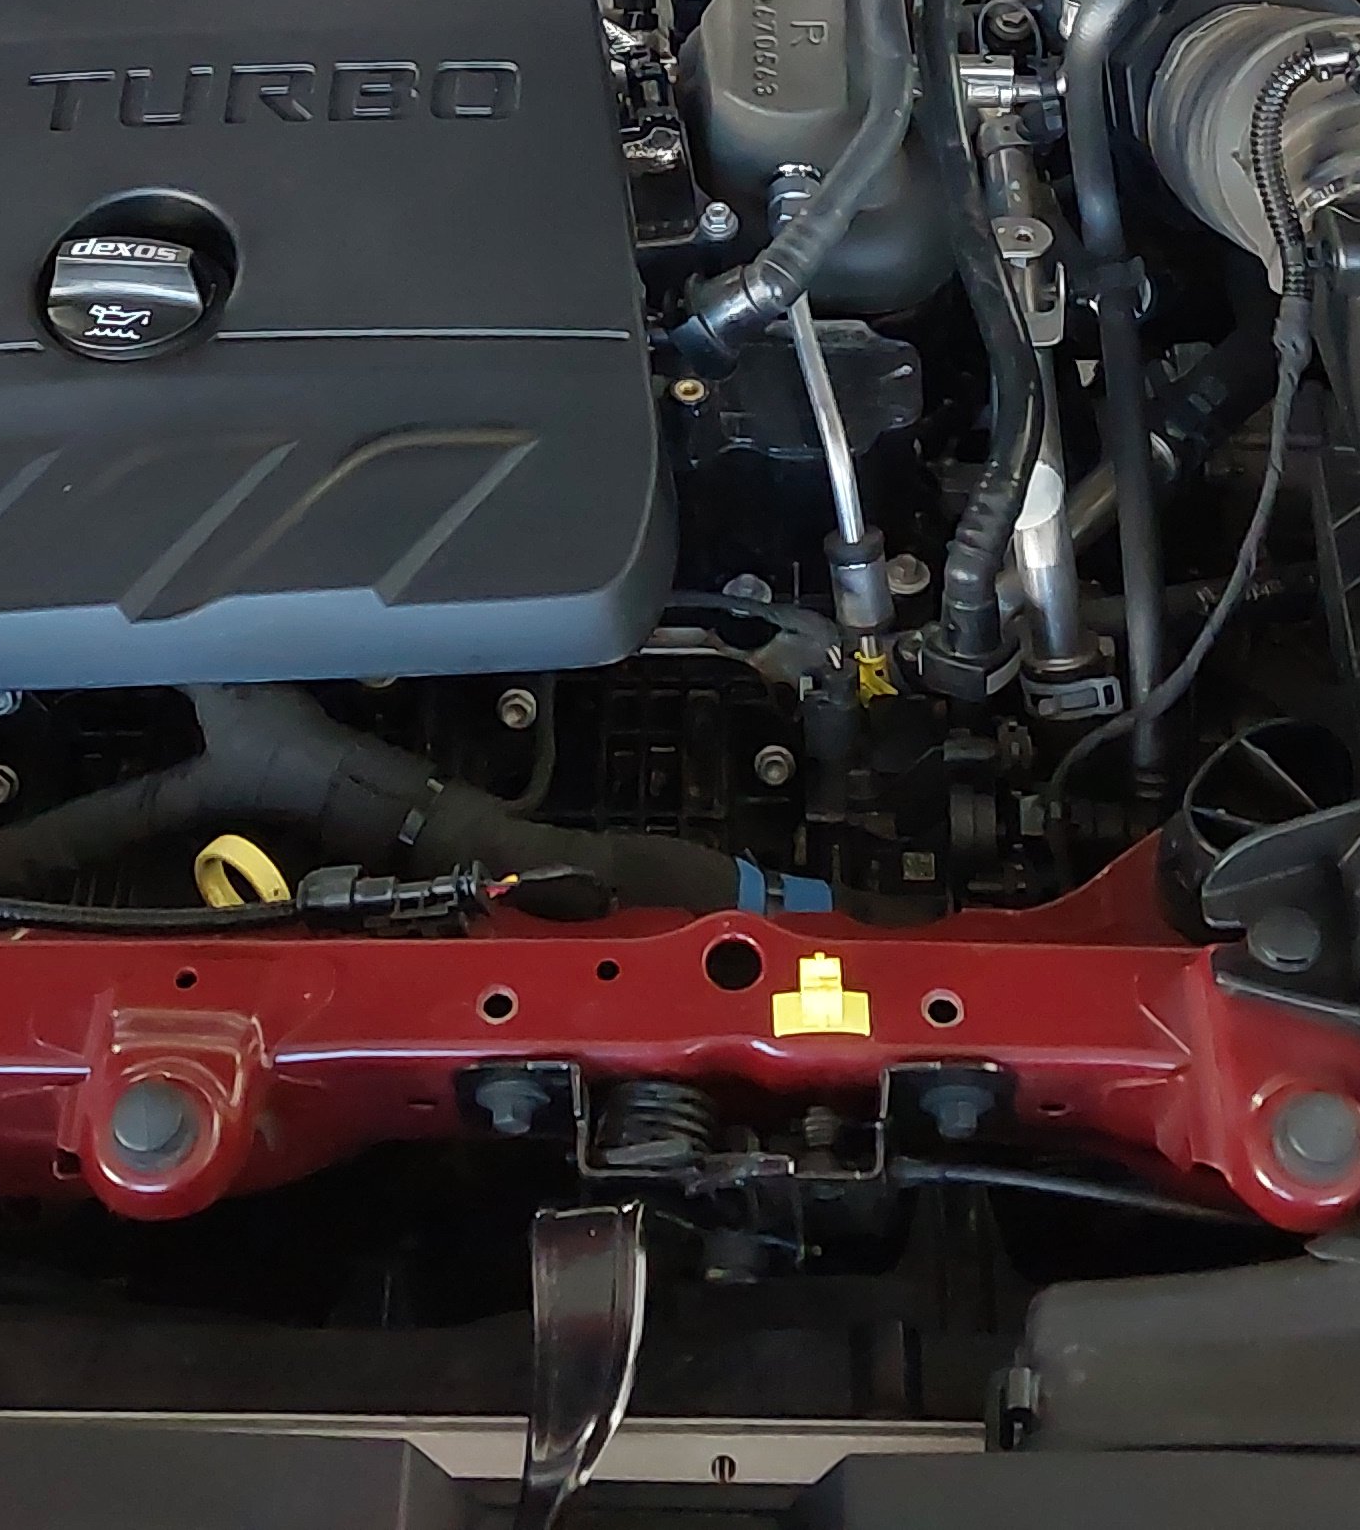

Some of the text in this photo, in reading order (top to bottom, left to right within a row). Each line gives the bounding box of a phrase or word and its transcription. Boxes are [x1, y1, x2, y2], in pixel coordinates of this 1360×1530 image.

[790, 21, 828, 46] R
[28, 60, 520, 131] TURBO
[70, 238, 180, 261] dexos
